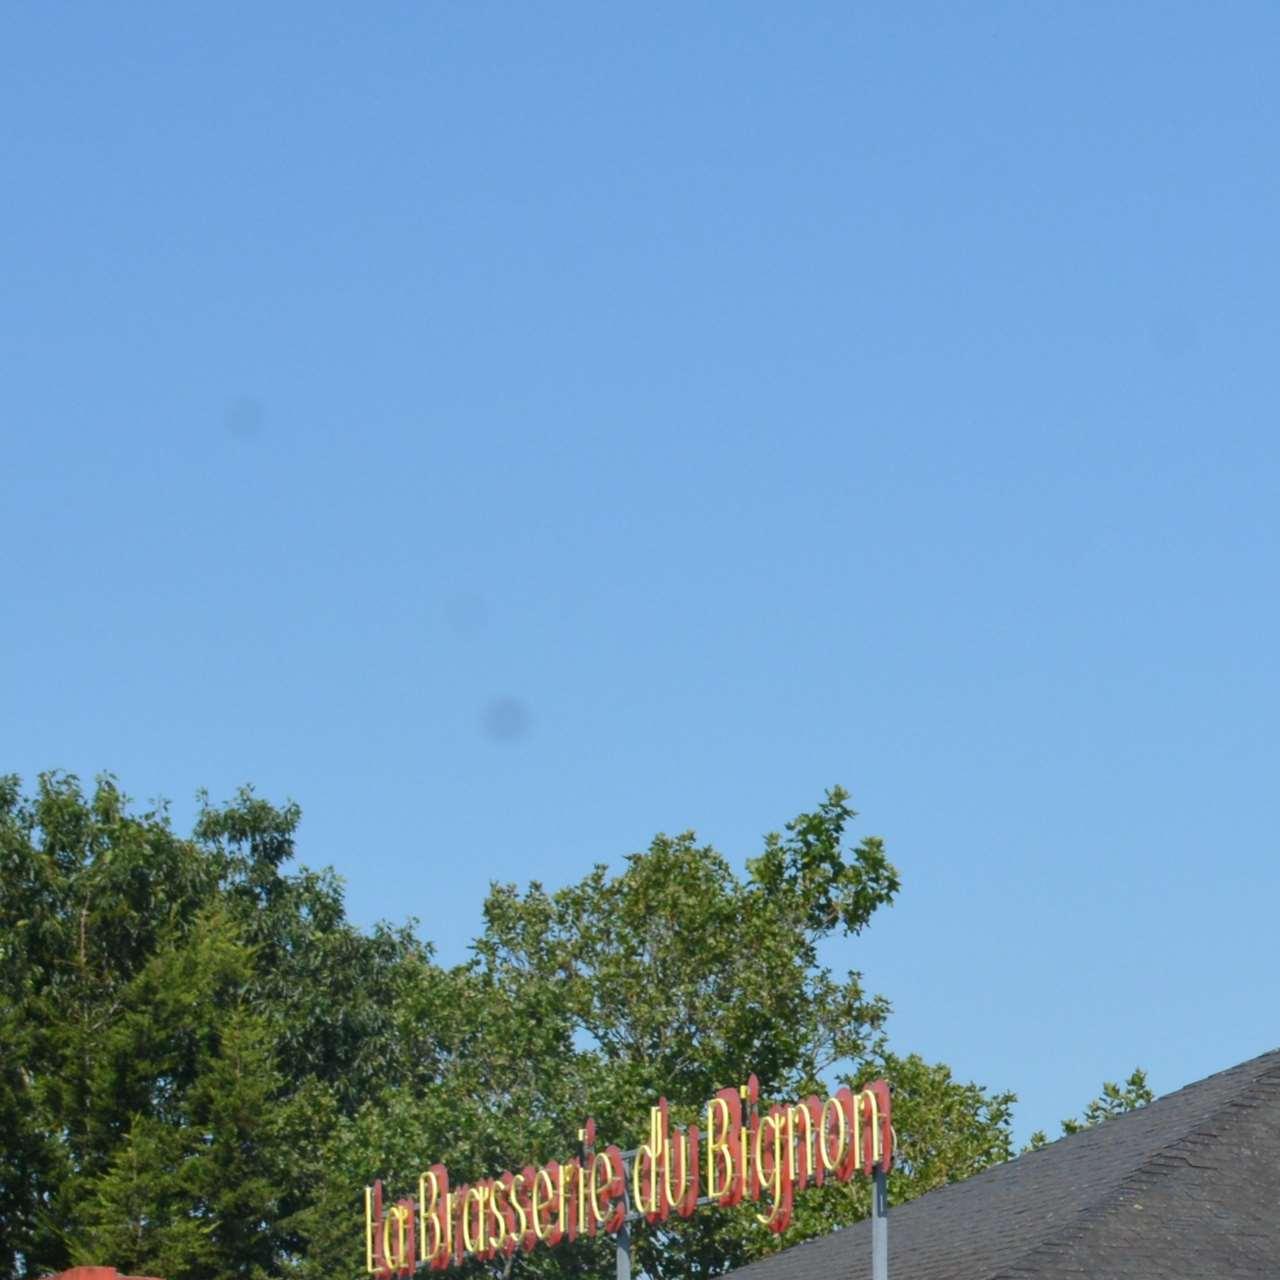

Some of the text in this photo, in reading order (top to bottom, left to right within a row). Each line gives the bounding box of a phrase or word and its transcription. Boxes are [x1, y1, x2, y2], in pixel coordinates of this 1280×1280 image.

[419, 1117, 625, 1269] Brasserie
[633, 1096, 698, 1225] du
[707, 1073, 897, 1233] Bignon
